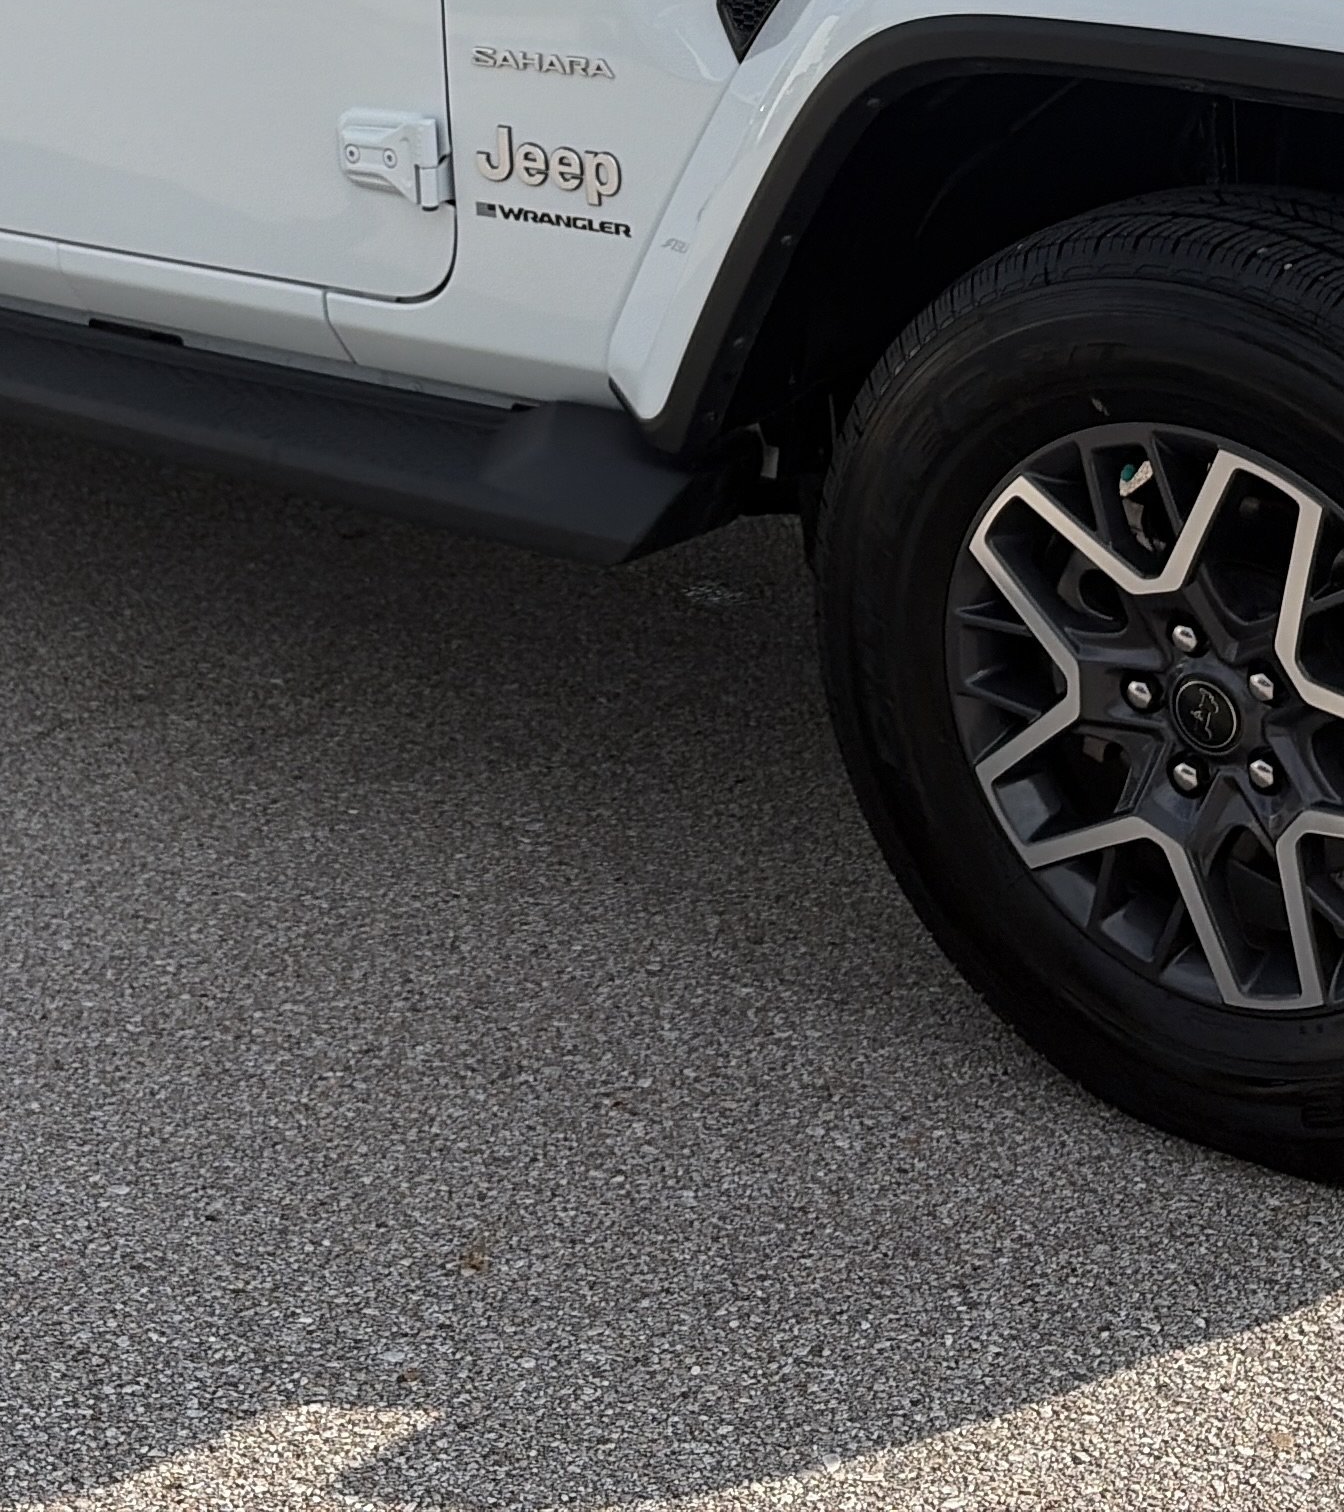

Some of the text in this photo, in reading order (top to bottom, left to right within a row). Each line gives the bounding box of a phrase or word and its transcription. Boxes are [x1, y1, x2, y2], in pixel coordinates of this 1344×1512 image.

[471, 45, 617, 80] SAHARA
[476, 124, 623, 207] Jeep
[497, 204, 632, 239] WRANGLER
